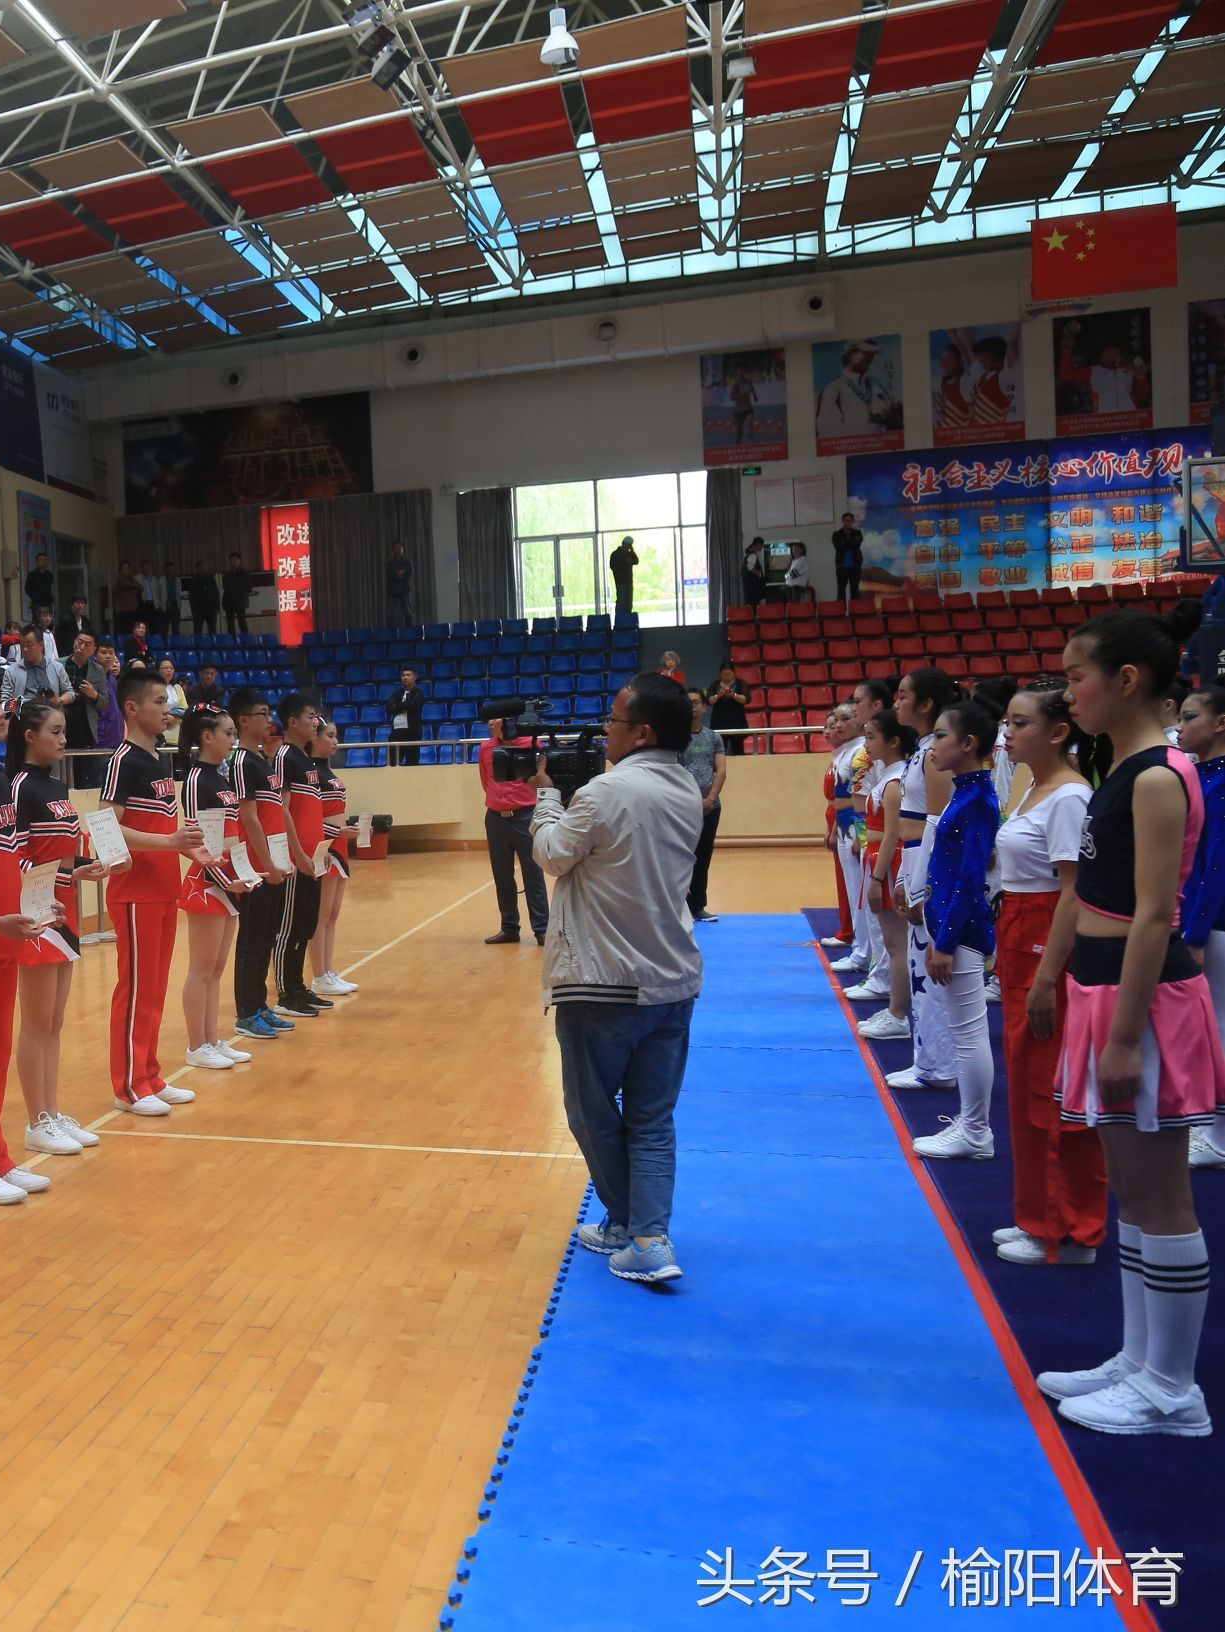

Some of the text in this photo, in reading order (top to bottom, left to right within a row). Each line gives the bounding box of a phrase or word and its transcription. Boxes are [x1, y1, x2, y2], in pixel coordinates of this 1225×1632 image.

[902, 443, 1183, 502] 社会主义核心价值观
[979, 512, 1026, 535] 民主
[1045, 507, 1094, 529] 文明
[1112, 503, 1164, 524] 和谐
[979, 539, 1028, 560] 平等
[1045, 534, 1094, 555] 公正
[1112, 530, 1164, 552] 法治
[1045, 561, 1094, 582] 诚信
[1112, 558, 1164, 578] 友善
